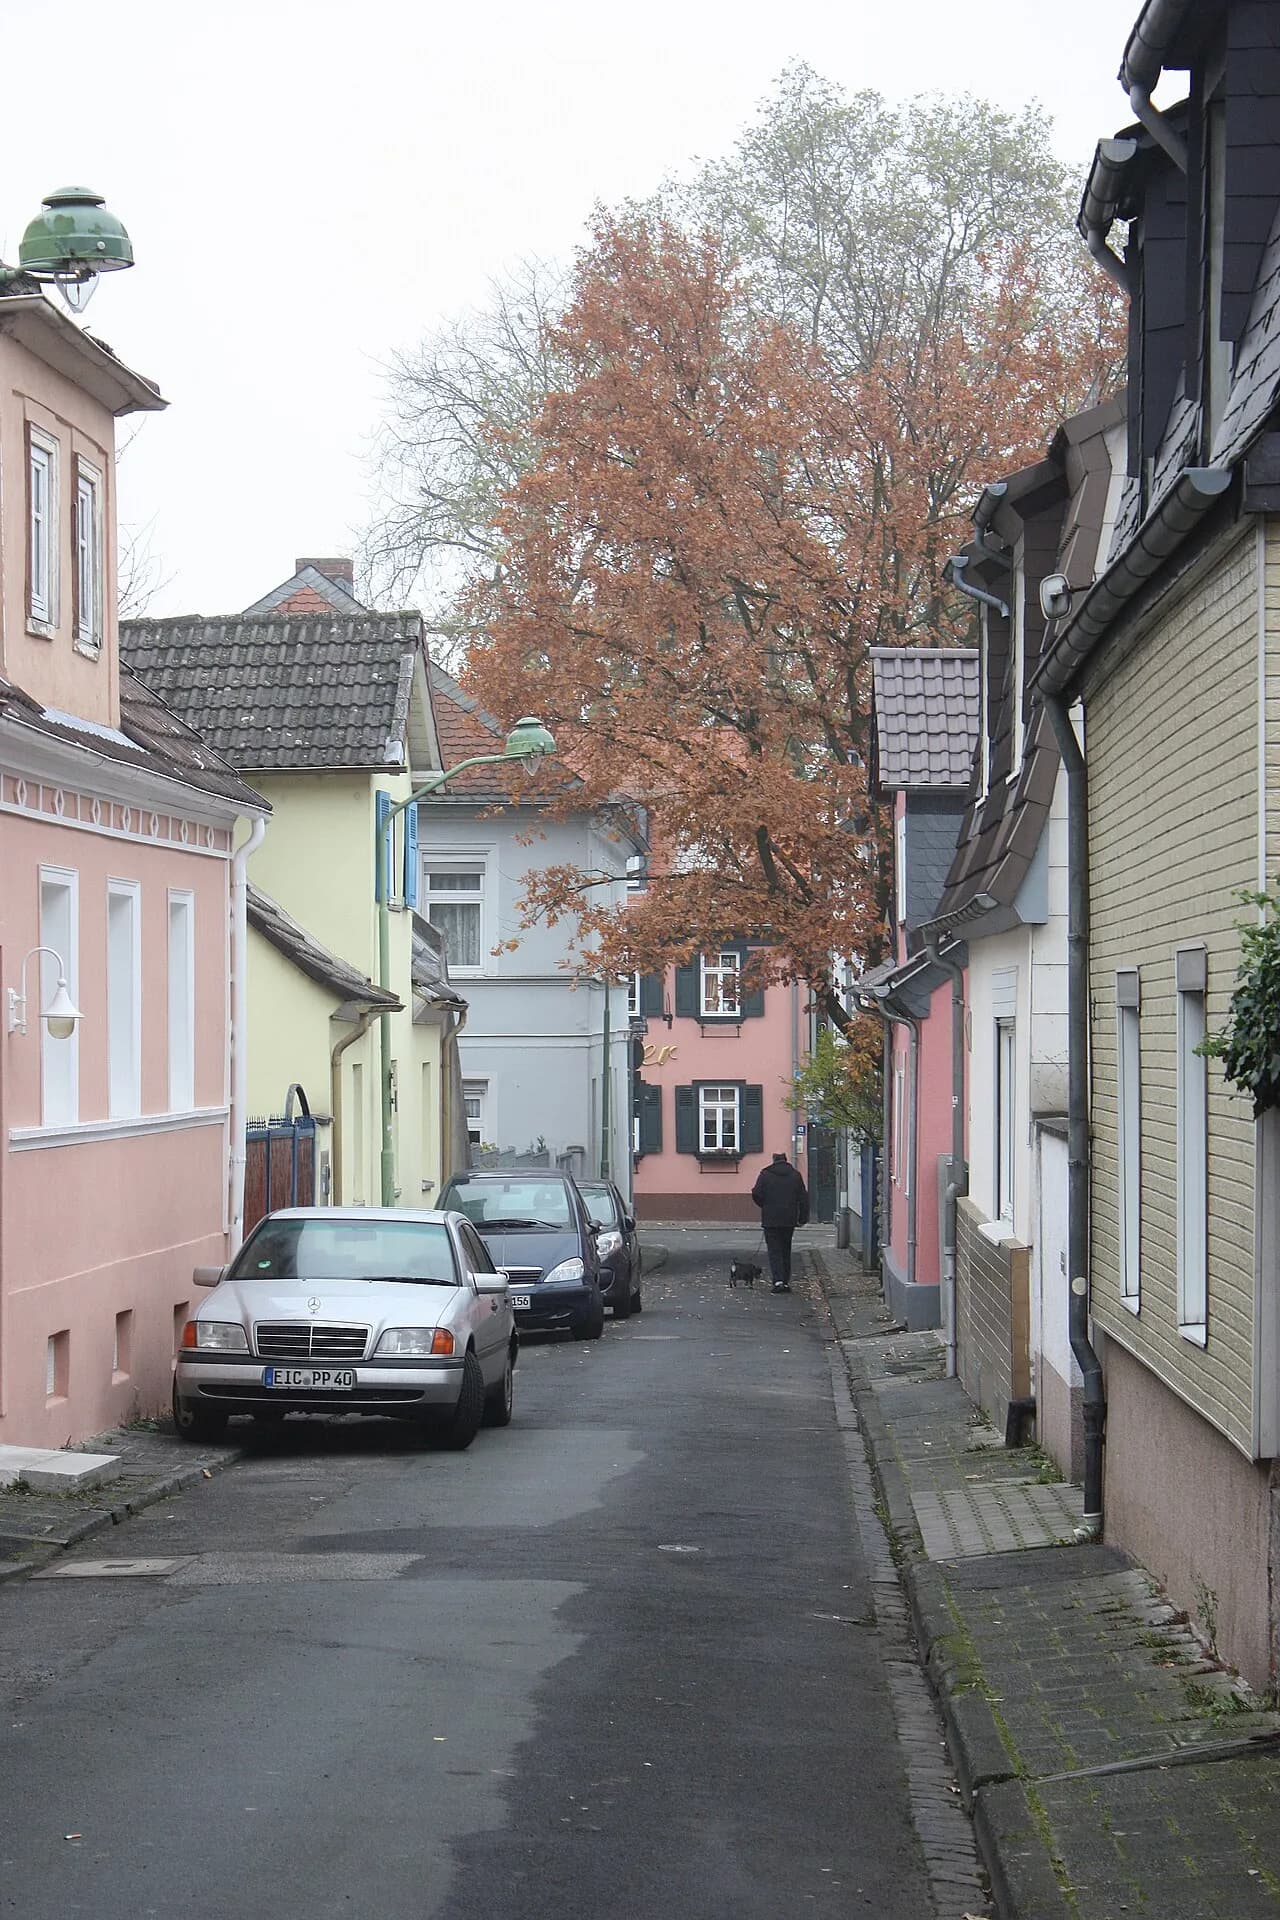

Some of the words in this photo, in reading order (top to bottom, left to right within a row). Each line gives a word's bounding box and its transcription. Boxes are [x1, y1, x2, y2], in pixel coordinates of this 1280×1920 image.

[512, 1296, 529, 1306] 156
[274, 1370, 302, 1385] EIC
[312, 1371, 331, 1385] PP
[333, 1372, 352, 1386] 40
